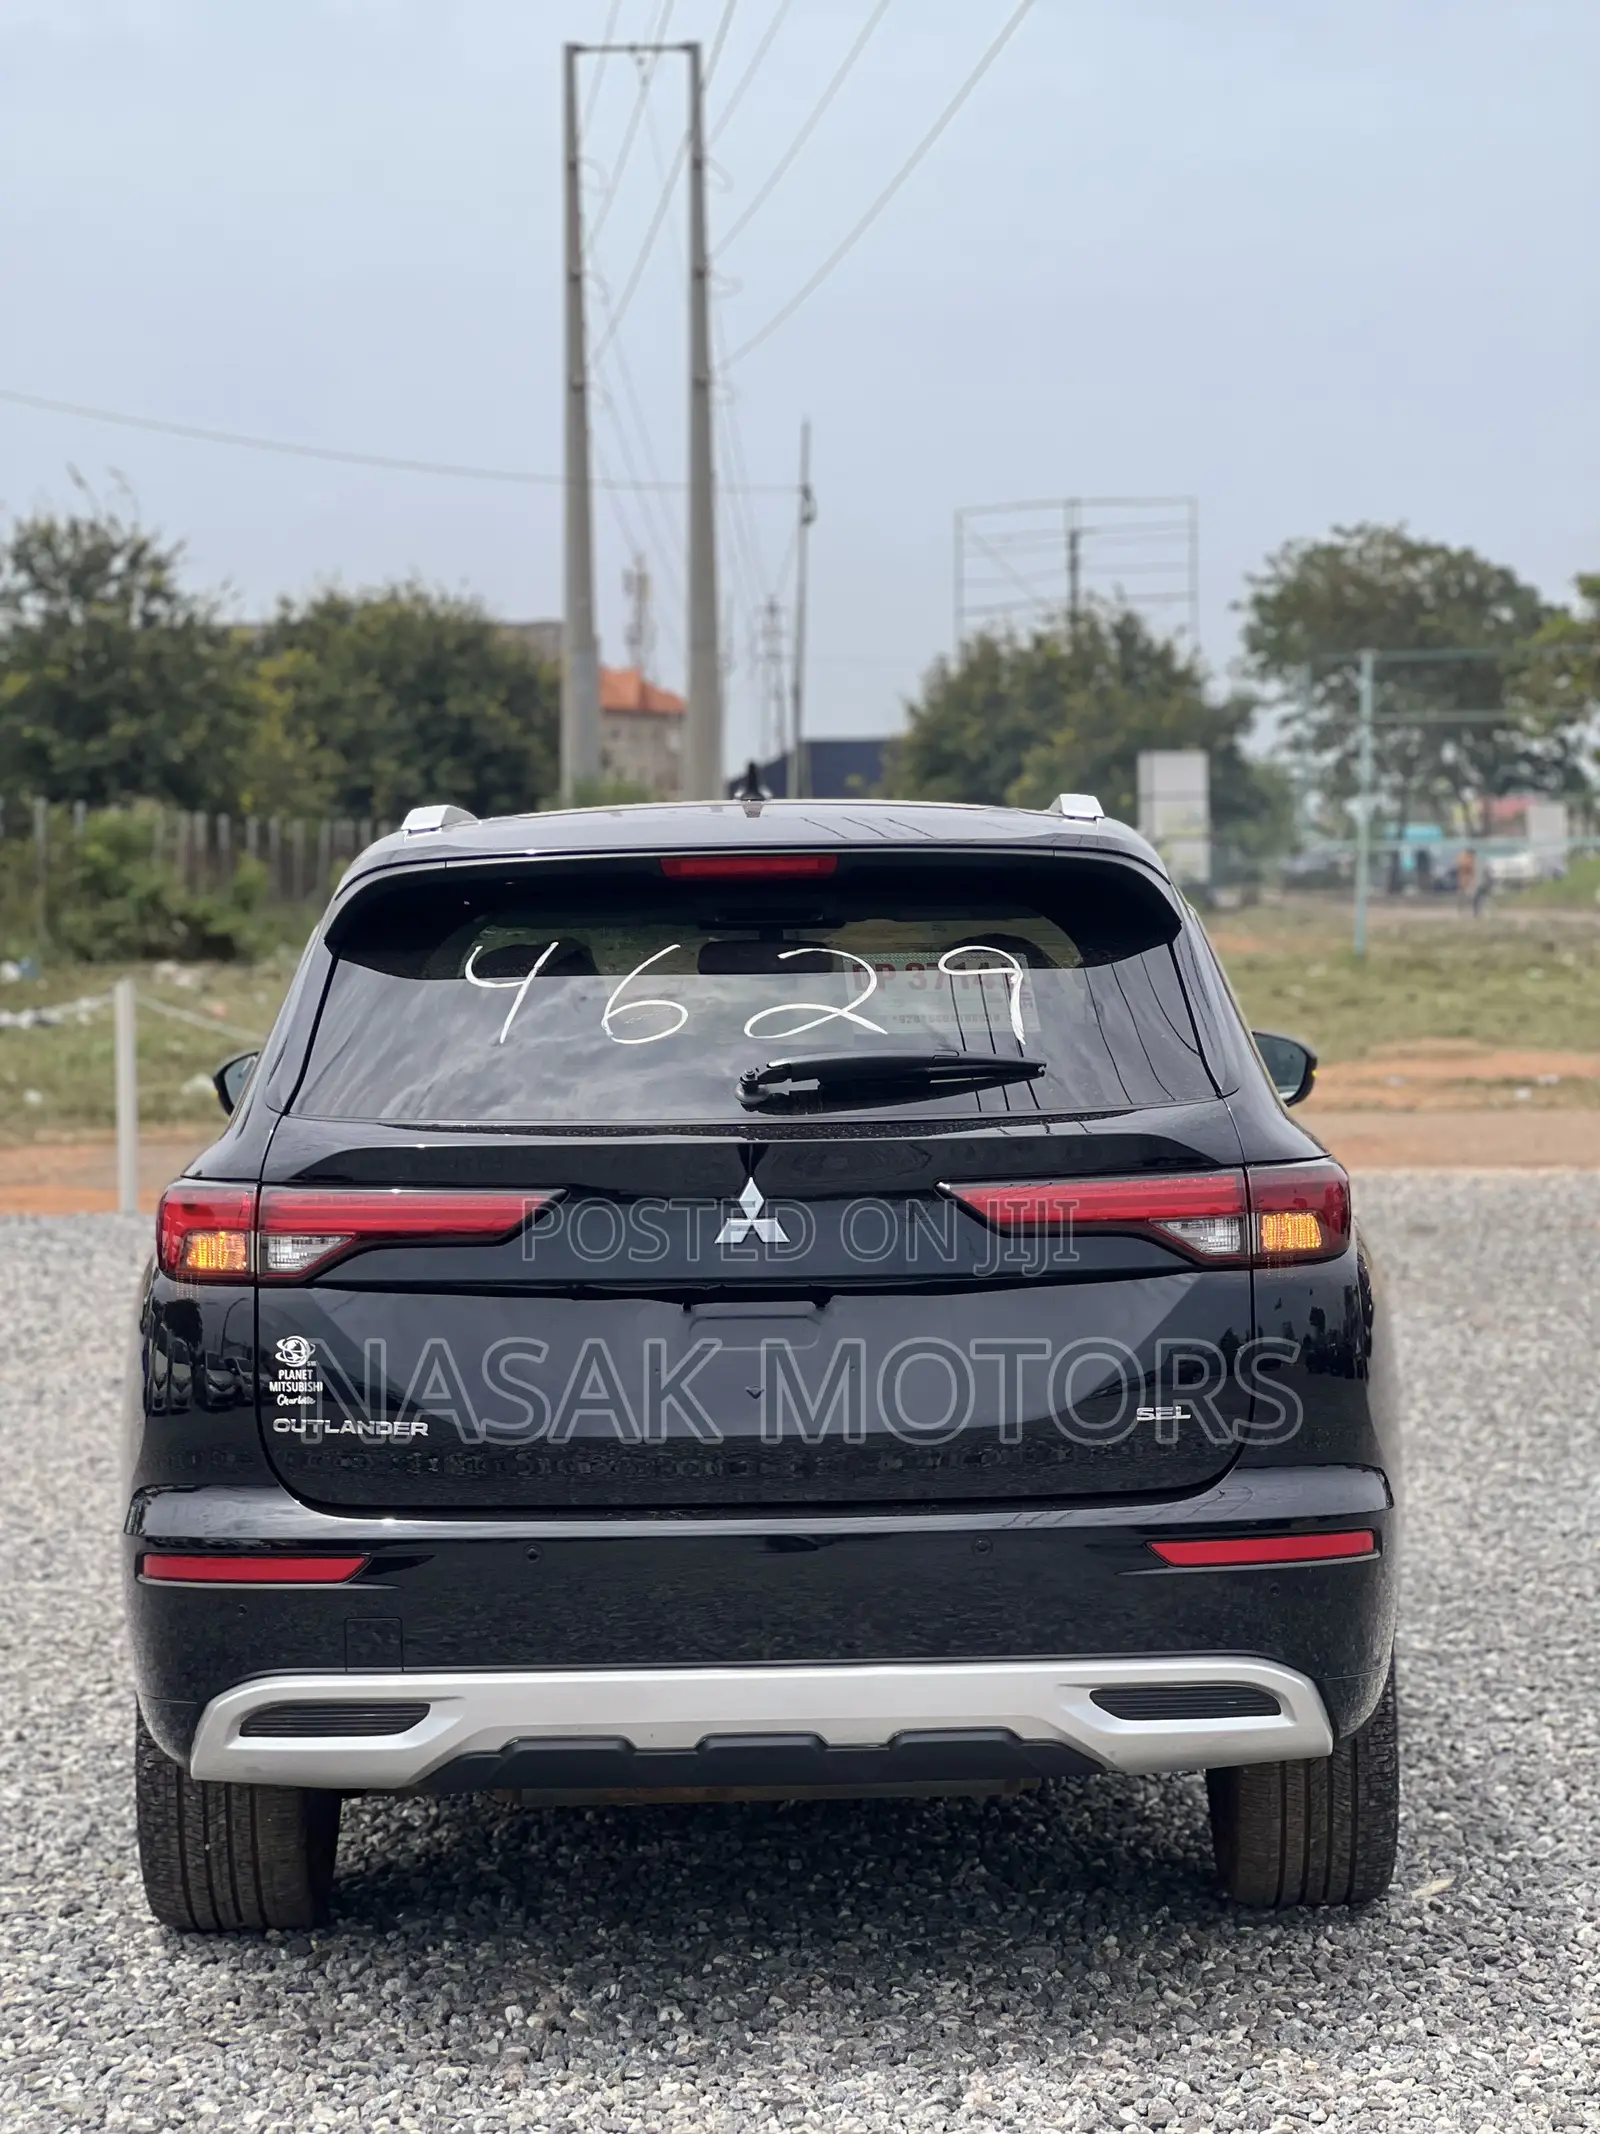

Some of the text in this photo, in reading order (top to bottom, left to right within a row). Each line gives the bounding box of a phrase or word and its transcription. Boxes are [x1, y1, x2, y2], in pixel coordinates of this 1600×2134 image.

[278, 1369, 314, 1380] PLANET
[269, 1381, 323, 1392] MITSUBISHI
[1136, 1405, 1192, 1421] SEL
[272, 1417, 429, 1437] OUTLANDER
